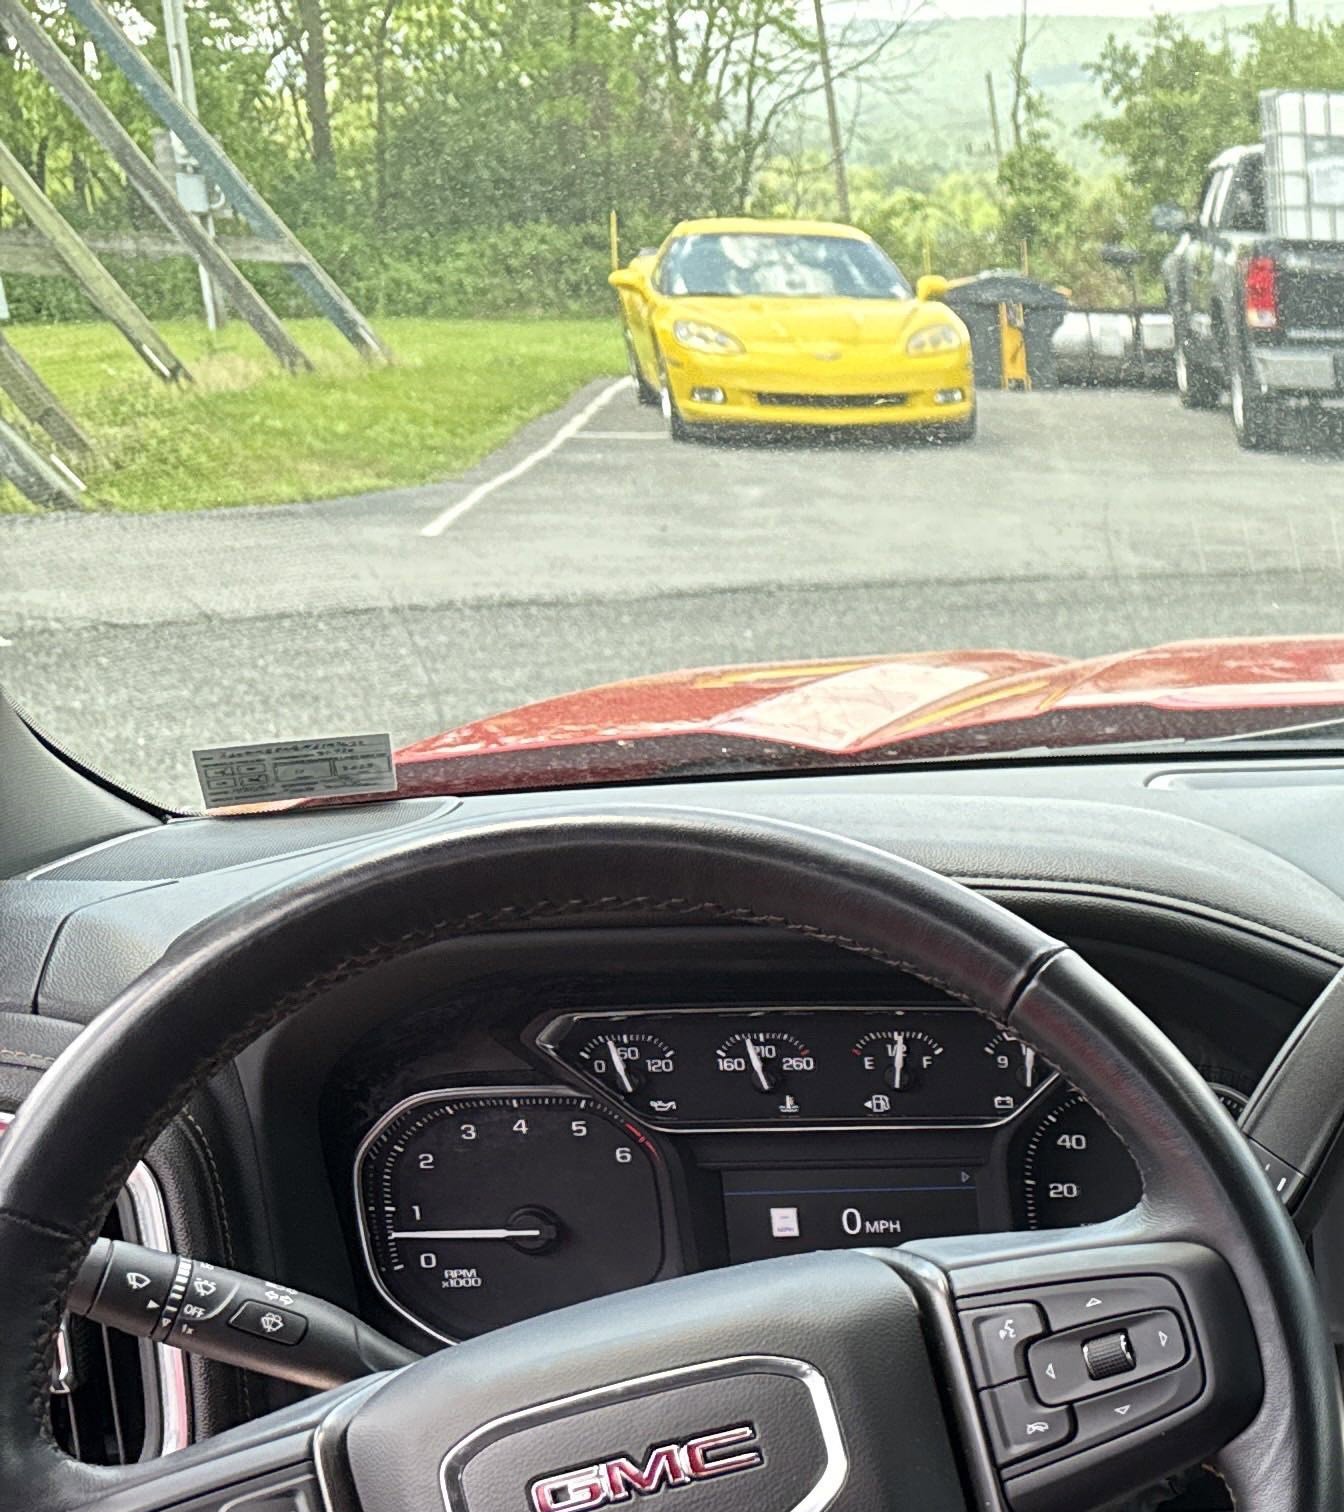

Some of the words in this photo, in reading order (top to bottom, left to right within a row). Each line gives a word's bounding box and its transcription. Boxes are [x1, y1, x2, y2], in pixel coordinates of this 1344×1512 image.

[594, 1060, 605, 1073] 0
[646, 1059, 674, 1073] 120
[717, 1058, 745, 1071] 160
[782, 1057, 814, 1071] 260
[864, 1056, 875, 1070] E
[922, 1055, 932, 1069] F
[460, 1124, 476, 1140] 3
[513, 1119, 529, 1135] 4
[571, 1120, 587, 1136] 5
[1057, 1134, 1087, 1150] 40
[418, 1153, 434, 1169] 2
[615, 1147, 632, 1163] 6
[1048, 1183, 1078, 1198] 20
[412, 1205, 422, 1221] 1
[841, 1207, 862, 1235] 0
[865, 1220, 901, 1234] MPH
[419, 1253, 437, 1269] 0
[444, 1268, 477, 1278] RPM
[442, 1277, 482, 1288] x1000
[183, 1304, 206, 1318] OFF
